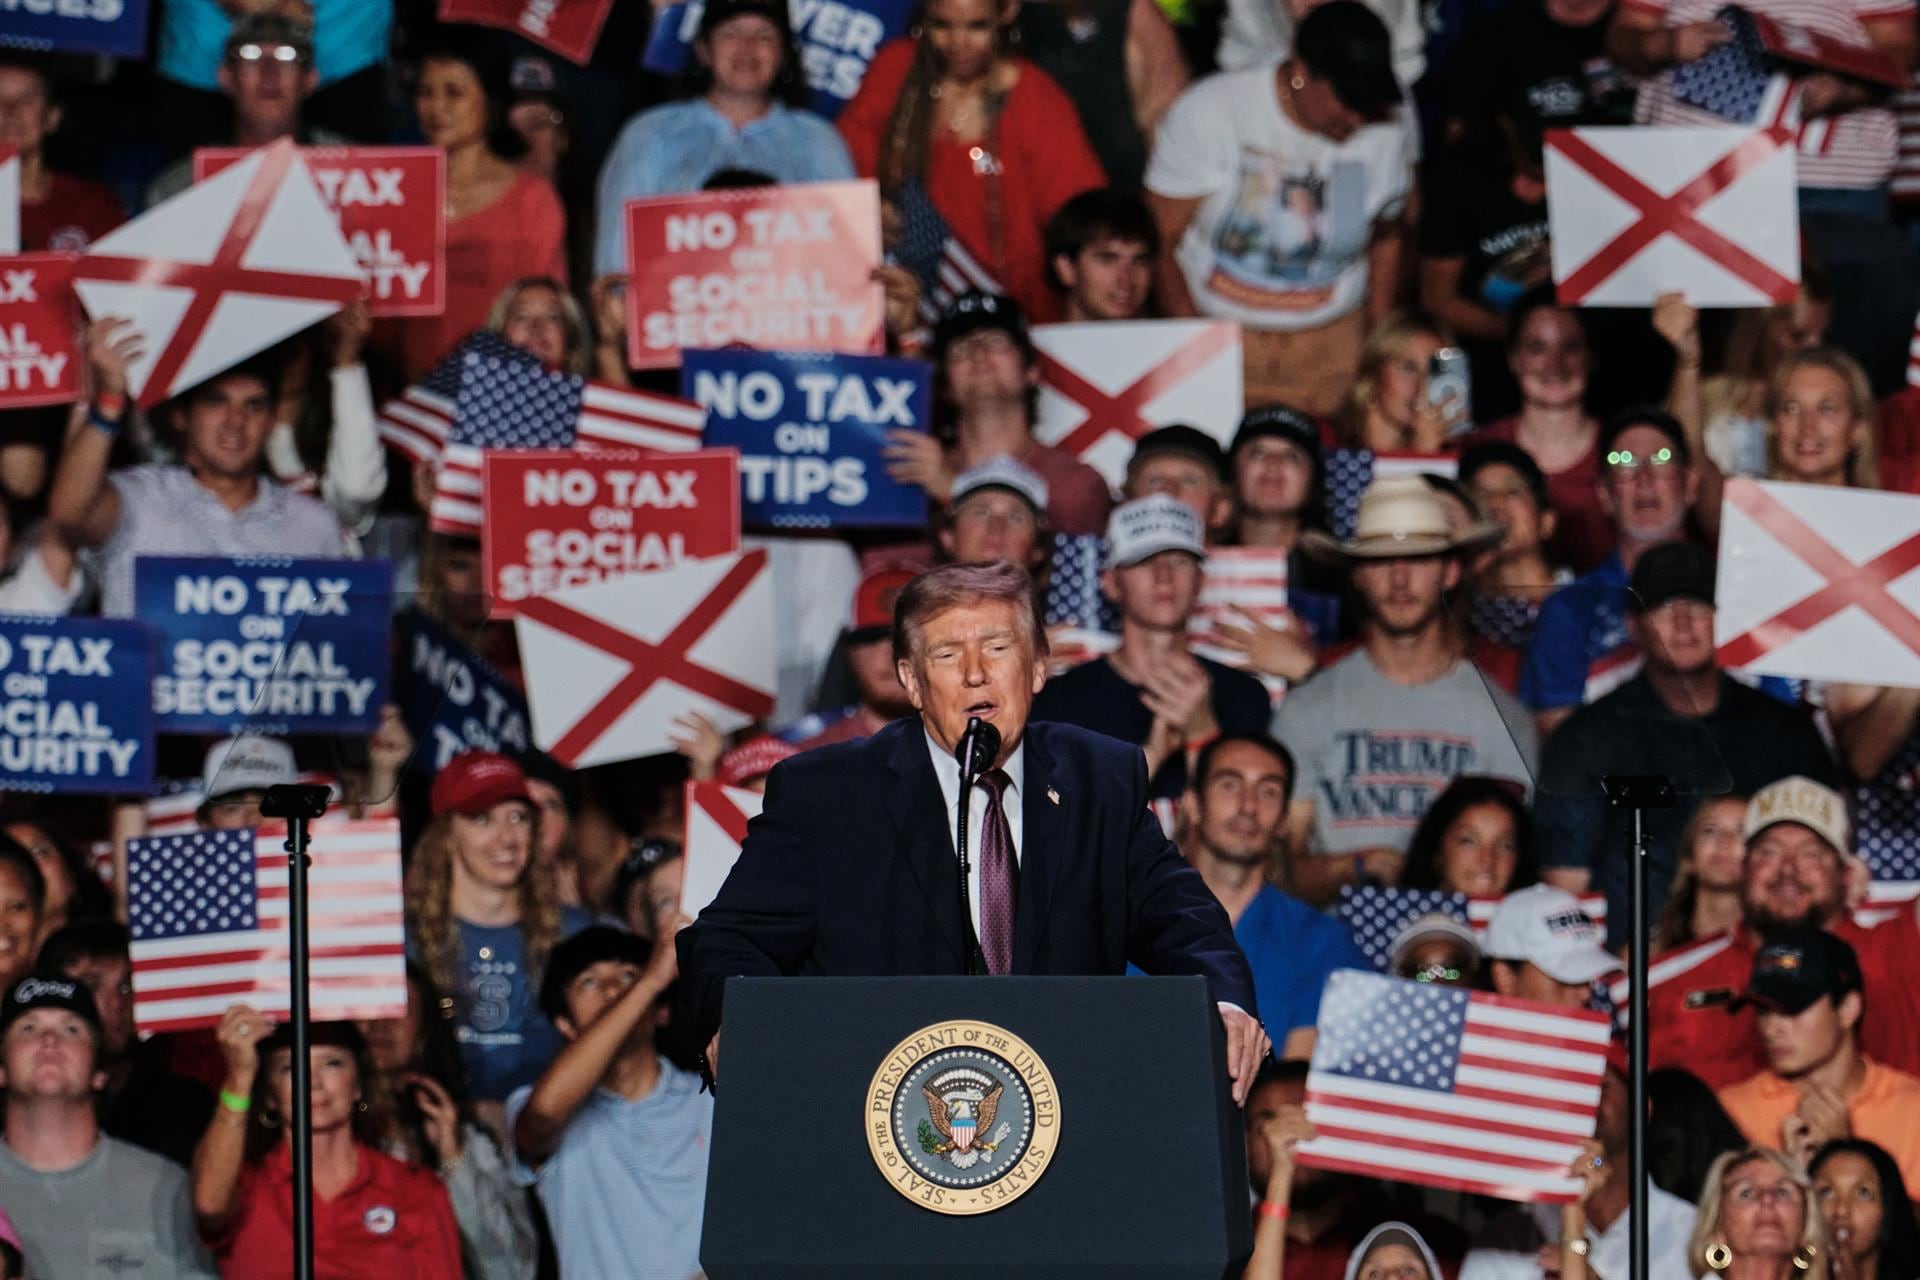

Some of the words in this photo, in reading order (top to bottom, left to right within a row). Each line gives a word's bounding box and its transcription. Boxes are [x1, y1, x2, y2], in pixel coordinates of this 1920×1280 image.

[317, 168, 406, 207] TAX
[665, 212, 737, 252] NO
[743, 207, 834, 244] TAX
[669, 271, 841, 312] SOCIAL
[644, 303, 864, 349] SECURITY
[694, 370, 785, 421] NO
[795, 374, 917, 425] TAX
[773, 422, 831, 454] ON
[524, 468, 598, 506] NO
[605, 470, 698, 508] TAX
[738, 455, 869, 507] TIPS
[589, 506, 634, 530] ON
[525, 529, 692, 570] SOCIAL
[174, 575, 249, 616] NO
[255, 576, 351, 617] TAX
[238, 614, 284, 640] ON
[20, 634, 114, 677] TAX
[173, 639, 349, 681] SOCIAL
[3, 671, 48, 698] ON
[152, 675, 377, 717] SECURITY
[1334, 728, 1477, 774] TRUMP
[963, 1028, 982, 1042] OF
[985, 1033, 1010, 1053] THE
[872, 1027, 958, 1114] PRESIDENT
[1012, 1049, 1055, 1128] UNITED
[874, 1119, 889, 1146] THE
[882, 1150, 899, 1168] OF
[980, 1144, 1046, 1205] STATES
[897, 1165, 946, 1205] SEAL
